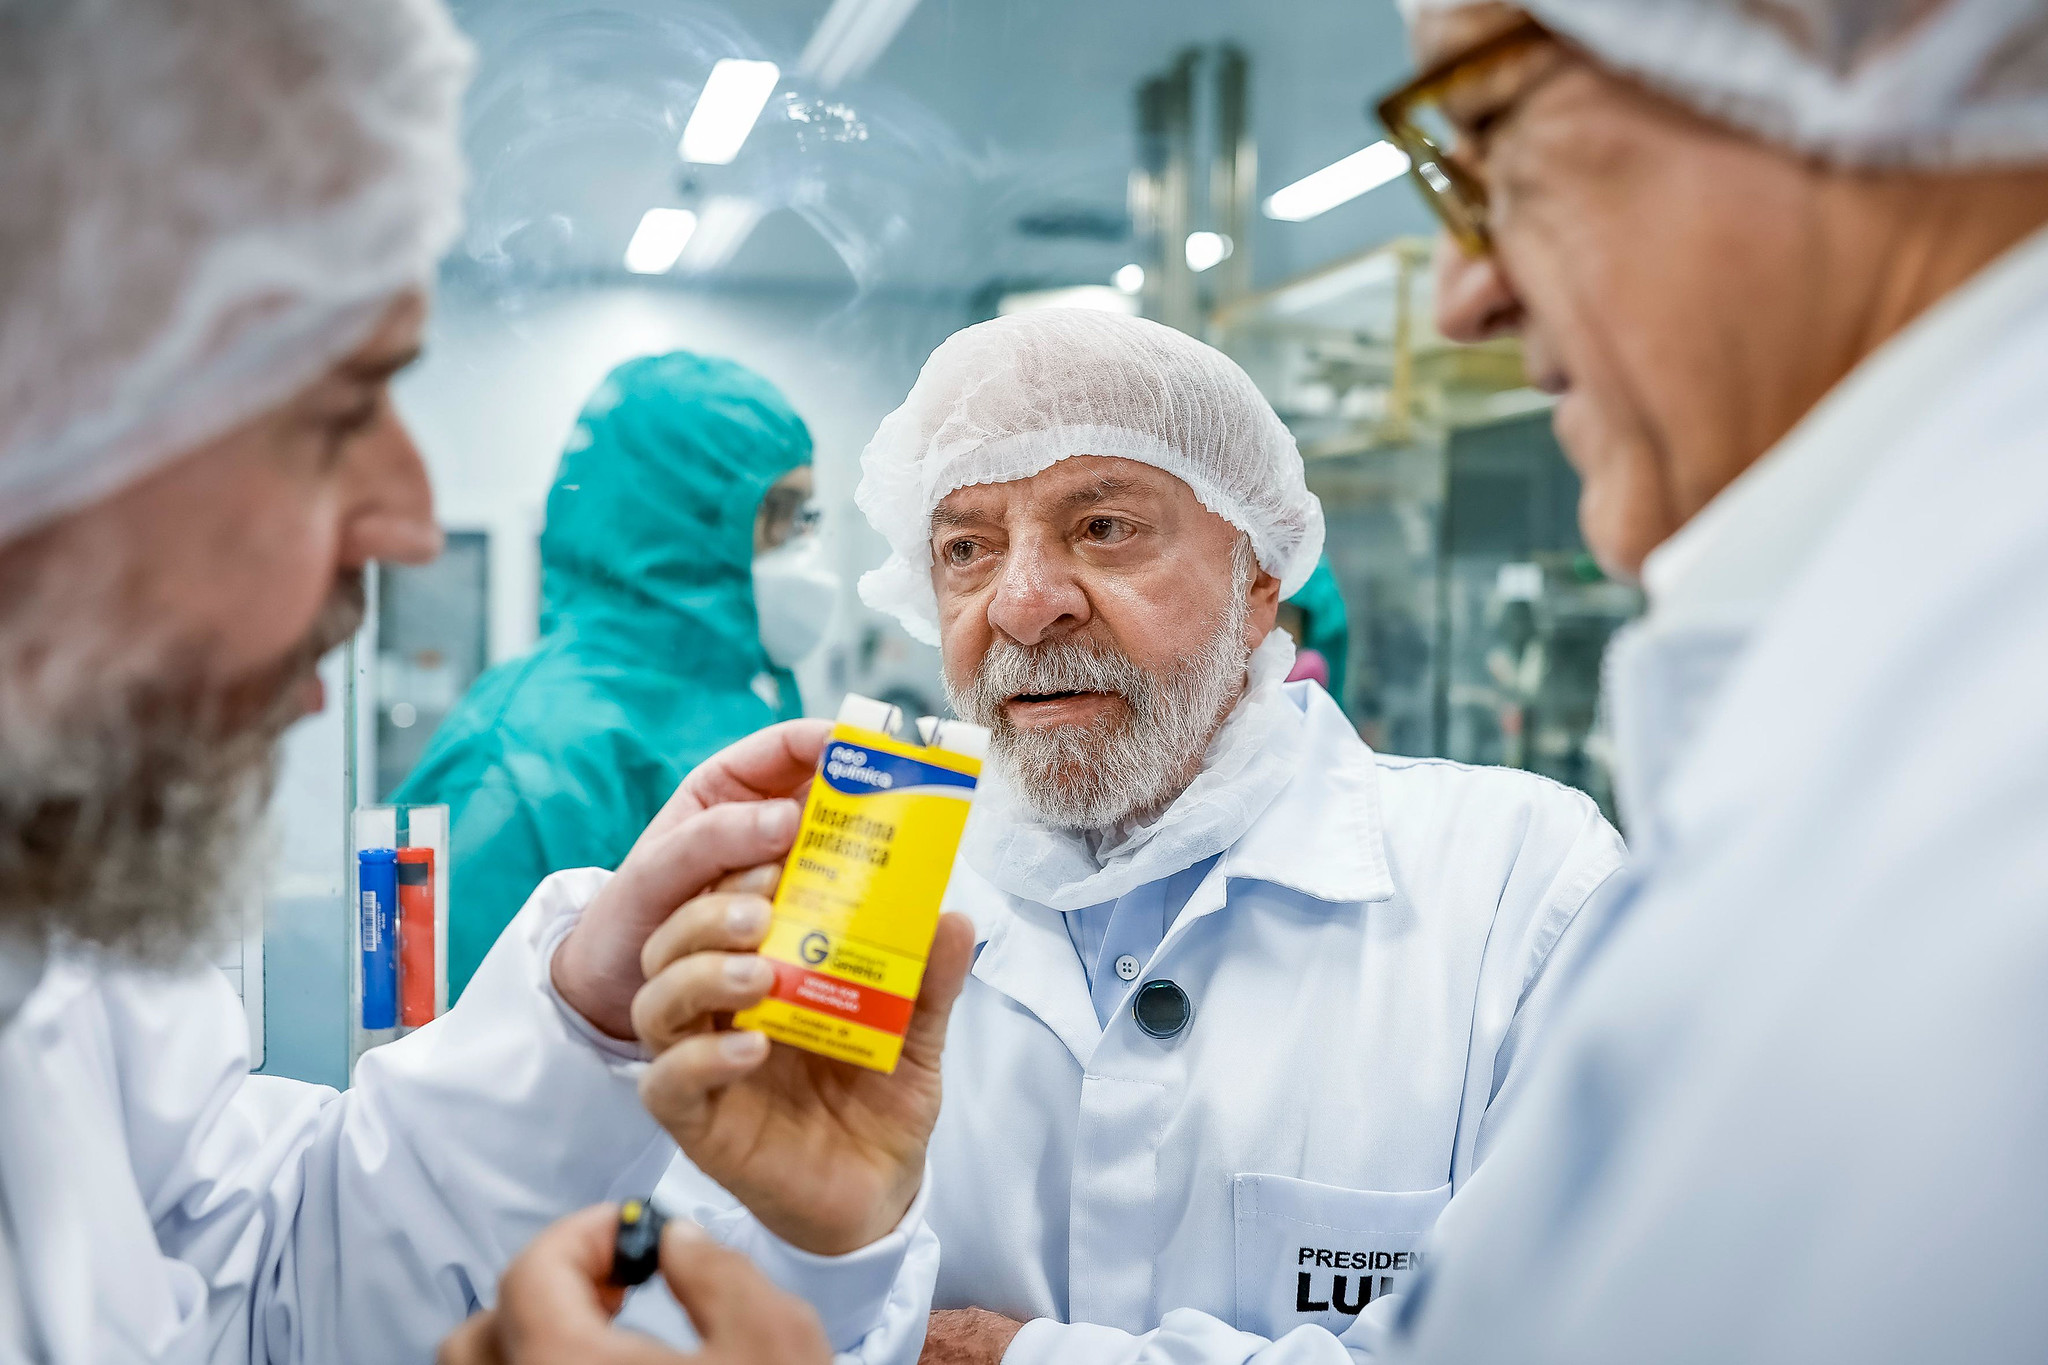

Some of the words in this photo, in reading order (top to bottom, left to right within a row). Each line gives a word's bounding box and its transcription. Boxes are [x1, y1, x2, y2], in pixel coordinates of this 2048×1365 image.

[831, 746, 867, 767] neo
[800, 931, 830, 966] G
[1298, 1247, 1425, 1271] PRESIDEN
[1296, 1271, 1394, 1315] LU
